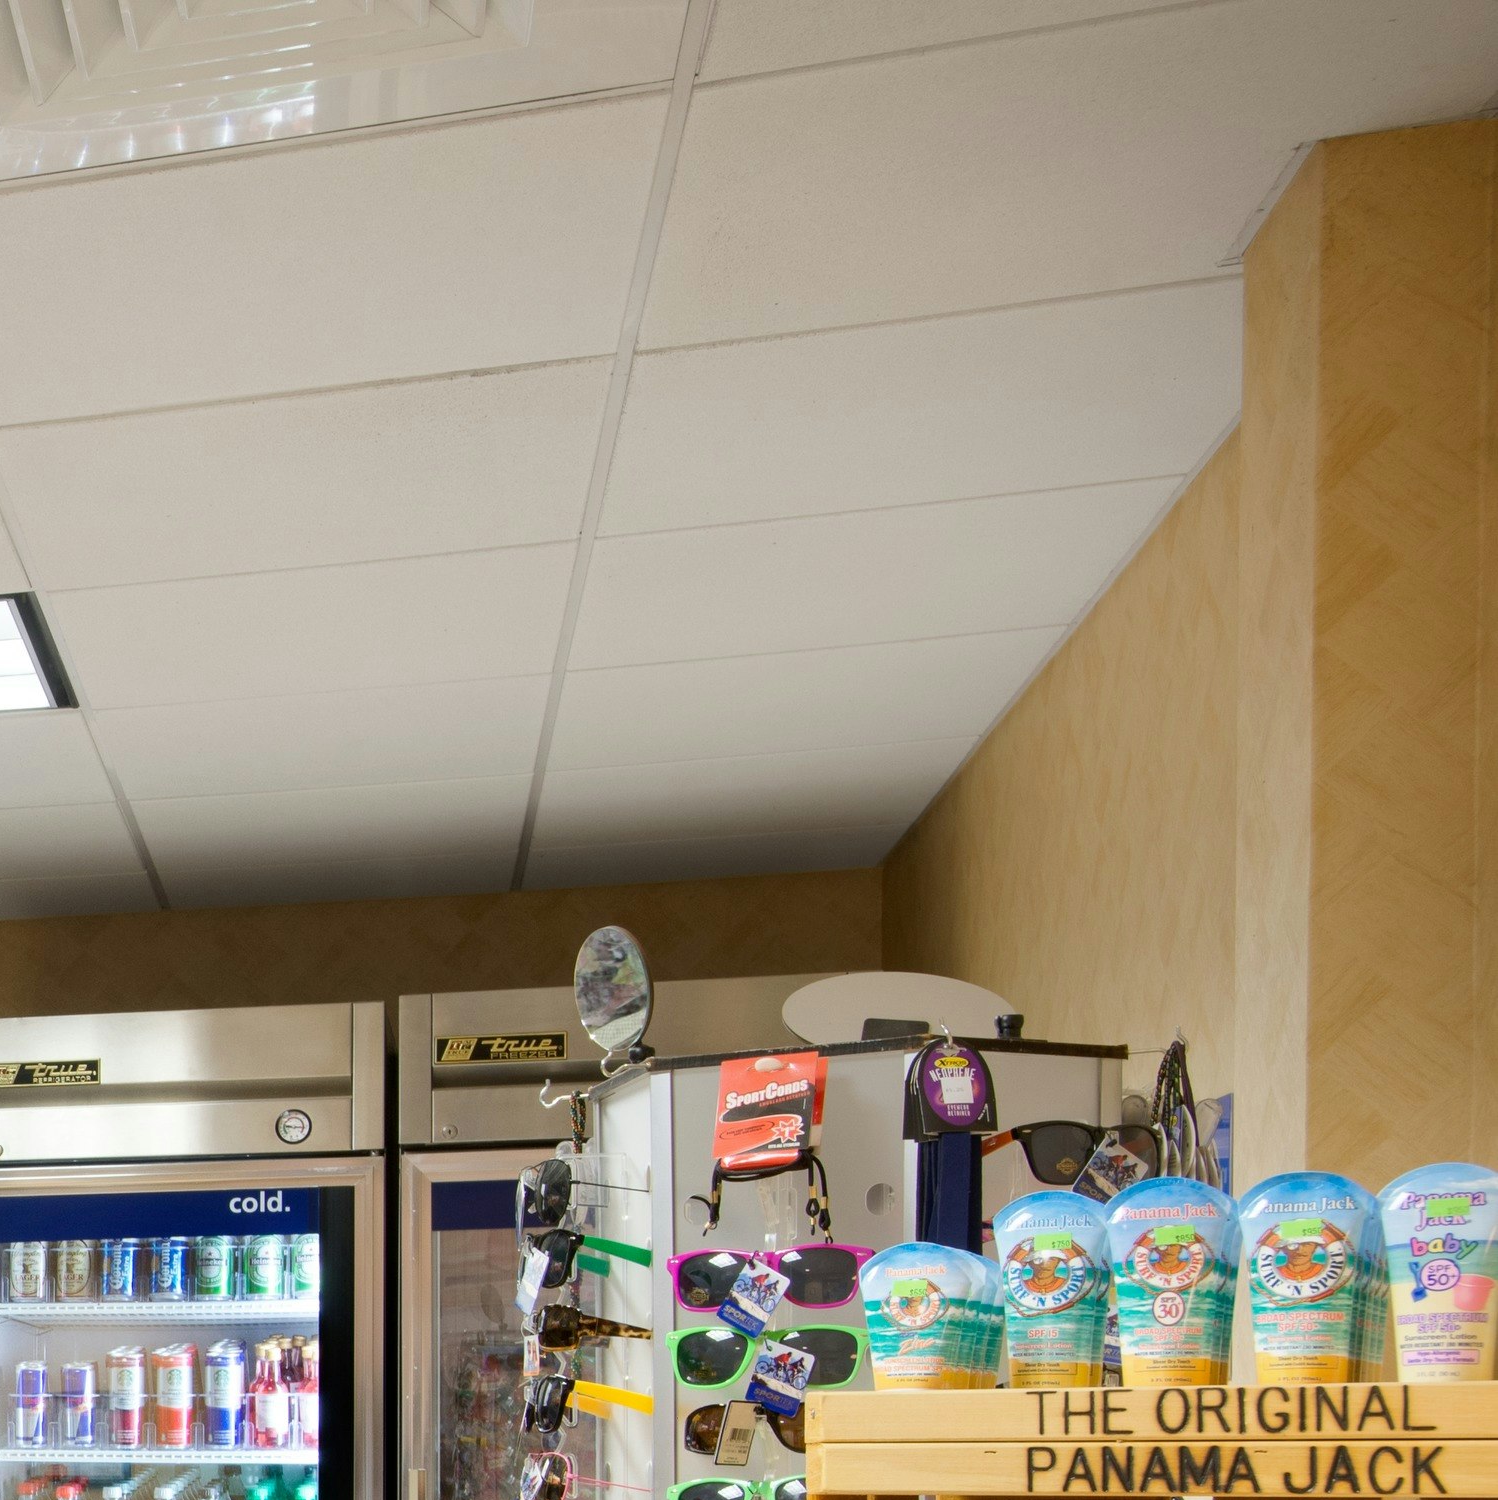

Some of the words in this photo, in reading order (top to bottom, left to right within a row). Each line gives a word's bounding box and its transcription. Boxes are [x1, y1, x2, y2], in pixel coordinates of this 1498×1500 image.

[481, 1037, 558, 1052] true
[490, 1051, 558, 1060] FREEZER
[929, 1066, 976, 1083] NEOPRENE
[229, 1190, 291, 1214] cold.
[1317, 1196, 1356, 1215] Jack
[1180, 1204, 1217, 1220] Jack
[1409, 1233, 1479, 1261] baby
[1428, 1264, 1451, 1275] SPF
[1027, 1389, 1134, 1436] THE
[1155, 1385, 1438, 1434] ORIGINAL
[1026, 1445, 1266, 1495] PANAMA
[1282, 1445, 1448, 1496] JACK
